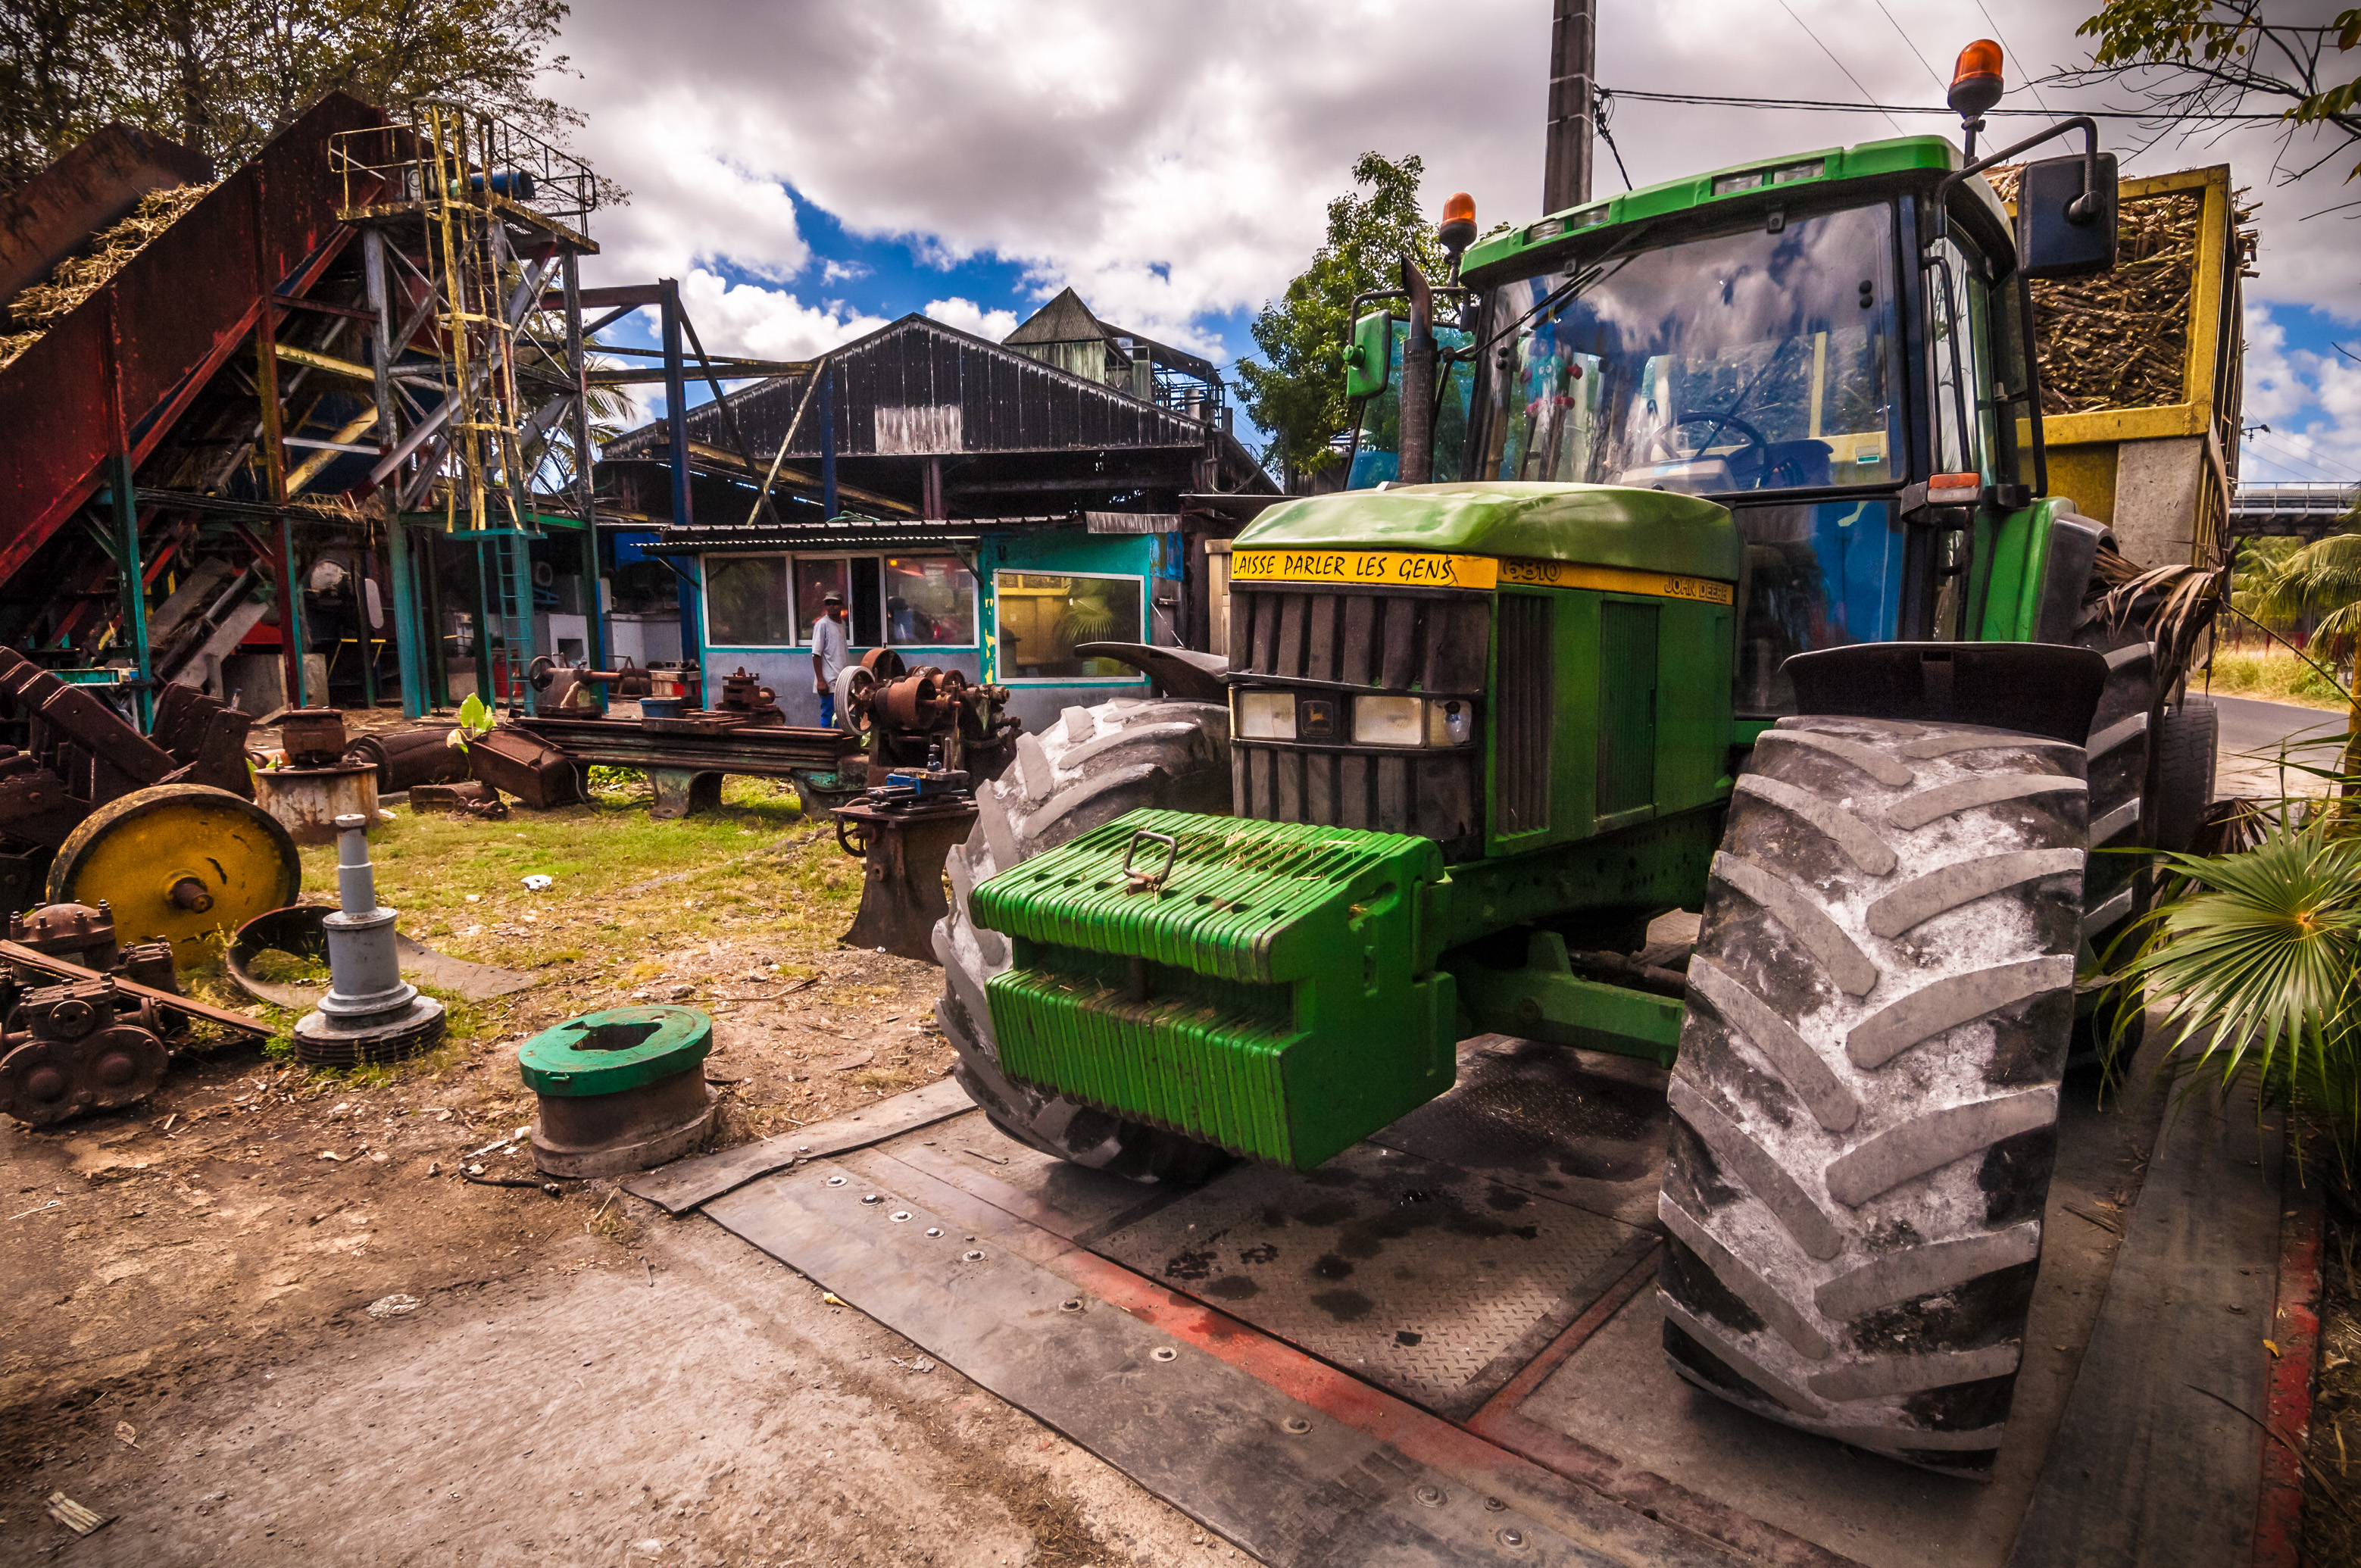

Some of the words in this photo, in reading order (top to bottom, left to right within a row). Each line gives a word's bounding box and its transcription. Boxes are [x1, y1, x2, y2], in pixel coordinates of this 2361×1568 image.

[1233, 555, 1276, 574] LAISSE
[1284, 555, 1345, 576] PARLER
[1356, 557, 1388, 577] LES
[1398, 557, 1454, 580] GENS
[1503, 559, 1560, 582] 6810
[1664, 576, 1696, 597] JOHN
[1699, 581, 1727, 601] DEERE
